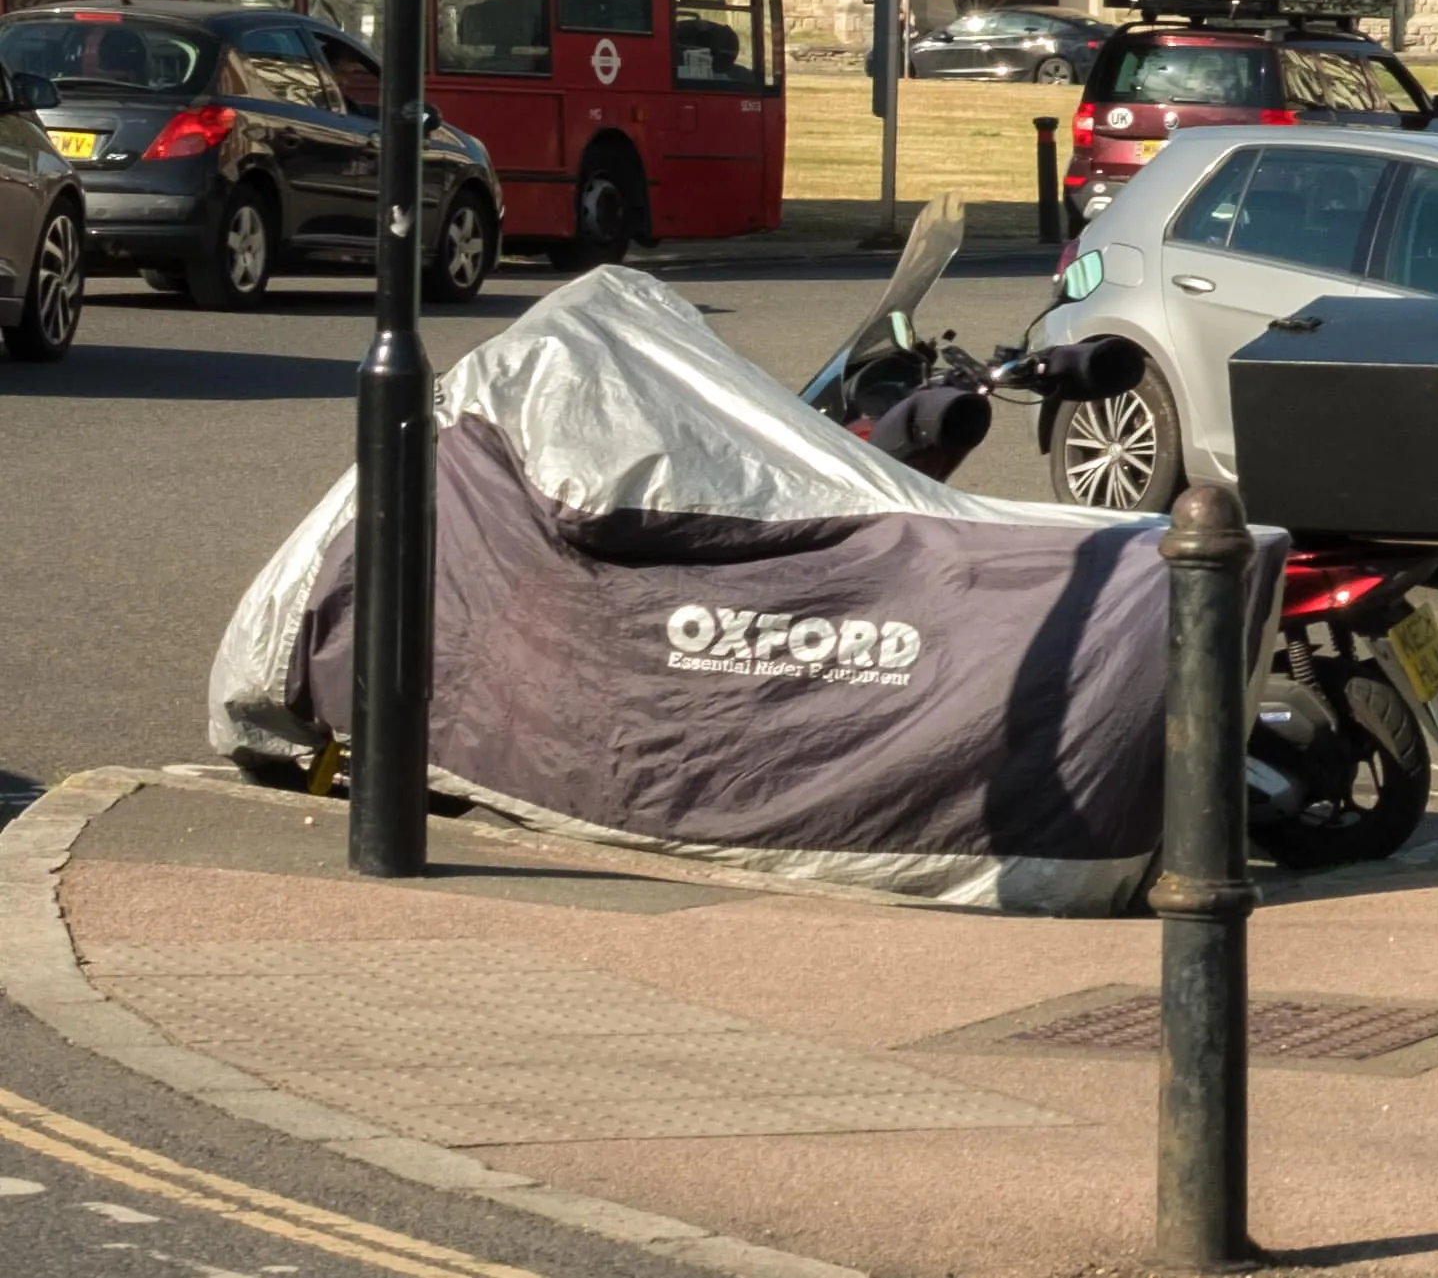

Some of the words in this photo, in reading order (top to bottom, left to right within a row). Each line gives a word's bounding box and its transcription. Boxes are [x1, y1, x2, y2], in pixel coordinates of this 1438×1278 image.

[1111, 113, 1128, 126] UK
[667, 605, 921, 669] OXFORD
[667, 651, 750, 675] Essential
[753, 659, 803, 679] Rider
